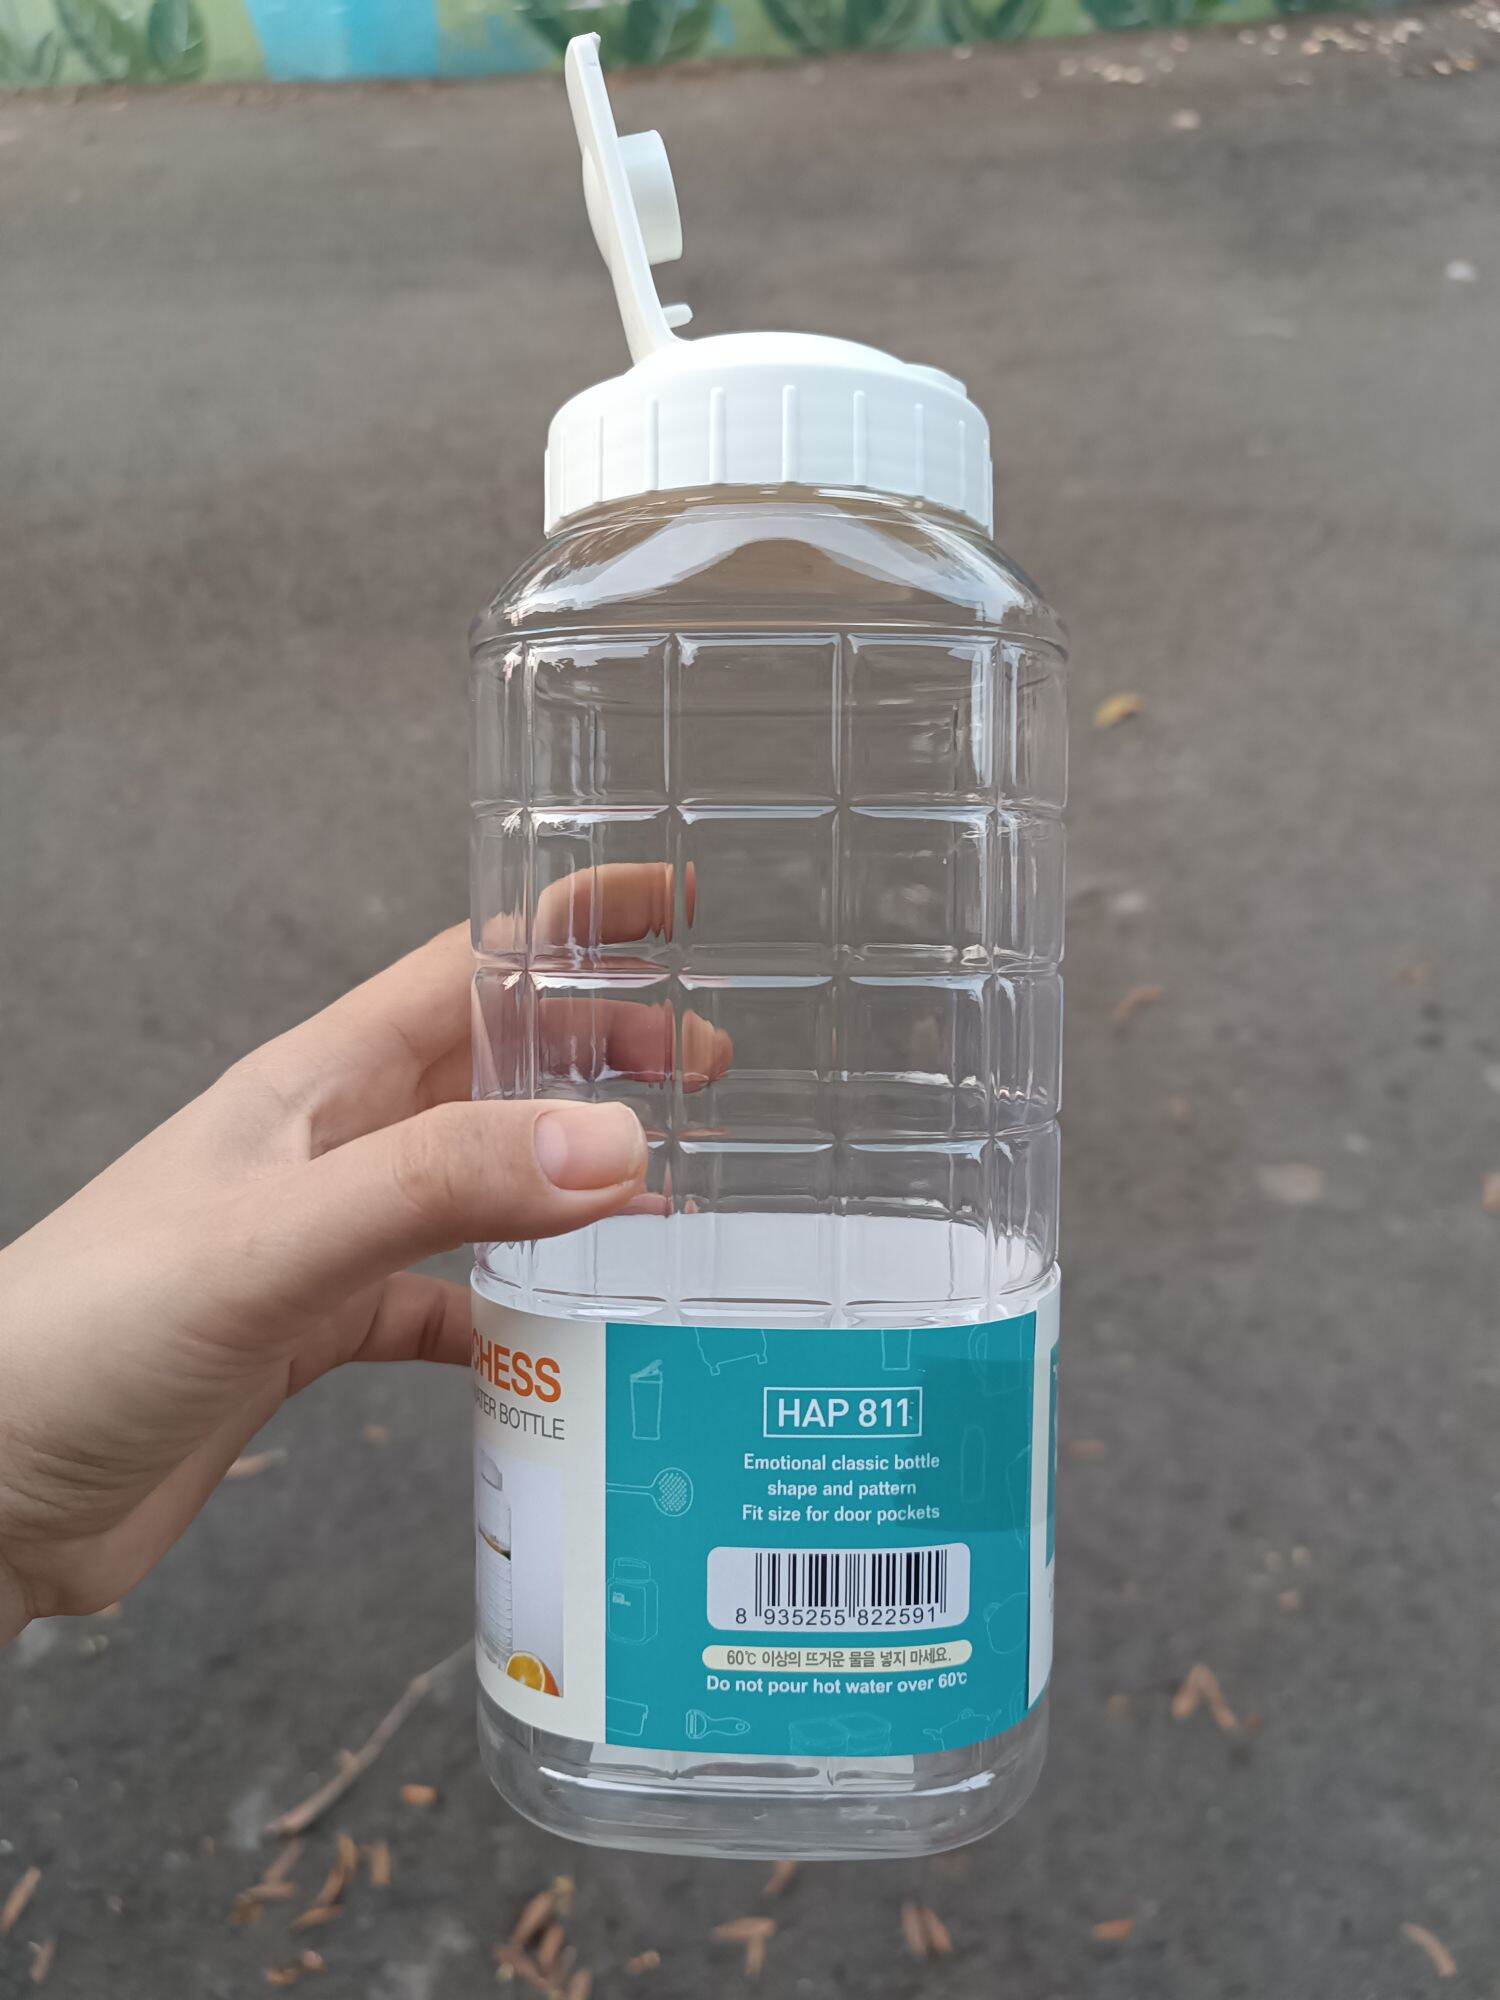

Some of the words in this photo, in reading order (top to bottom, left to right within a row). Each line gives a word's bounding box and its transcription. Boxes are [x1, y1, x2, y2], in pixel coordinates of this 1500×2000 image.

[472, 1327, 562, 1403] CHESS
[473, 1384, 497, 1419] ATER
[499, 1403, 565, 1441] BOTTLE
[778, 1398, 849, 1427] HAP
[858, 1397, 910, 1427] 811
[744, 1453, 826, 1470] Emotional
[831, 1454, 889, 1470] classic
[894, 1453, 940, 1469] bottle
[767, 1480, 818, 1499] shape
[823, 1480, 853, 1497] and
[858, 1480, 917, 1499] pattern
[742, 1504, 764, 1521] Fit
[768, 1505, 801, 1521] size
[806, 1505, 829, 1521] for
[833, 1505, 872, 1521] door
[877, 1503, 940, 1524] pockets
[735, 1608, 747, 1624] 8
[764, 1609, 846, 1626] 935255
[857, 1607, 936, 1625] 822591
[761, 1650, 801, 1667] 이상의
[805, 1651, 845, 1667] 뜨거운
[849, 1651, 876, 1667] 물을
[880, 1650, 906, 1667] 넣지
[910, 1647, 952, 1665] 마세요.
[706, 1675, 731, 1691] Do
[735, 1678, 763, 1692] not
[768, 1680, 808, 1695] pour
[813, 1678, 841, 1693] hot
[845, 1679, 893, 1694] water
[897, 1677, 934, 1692] over
